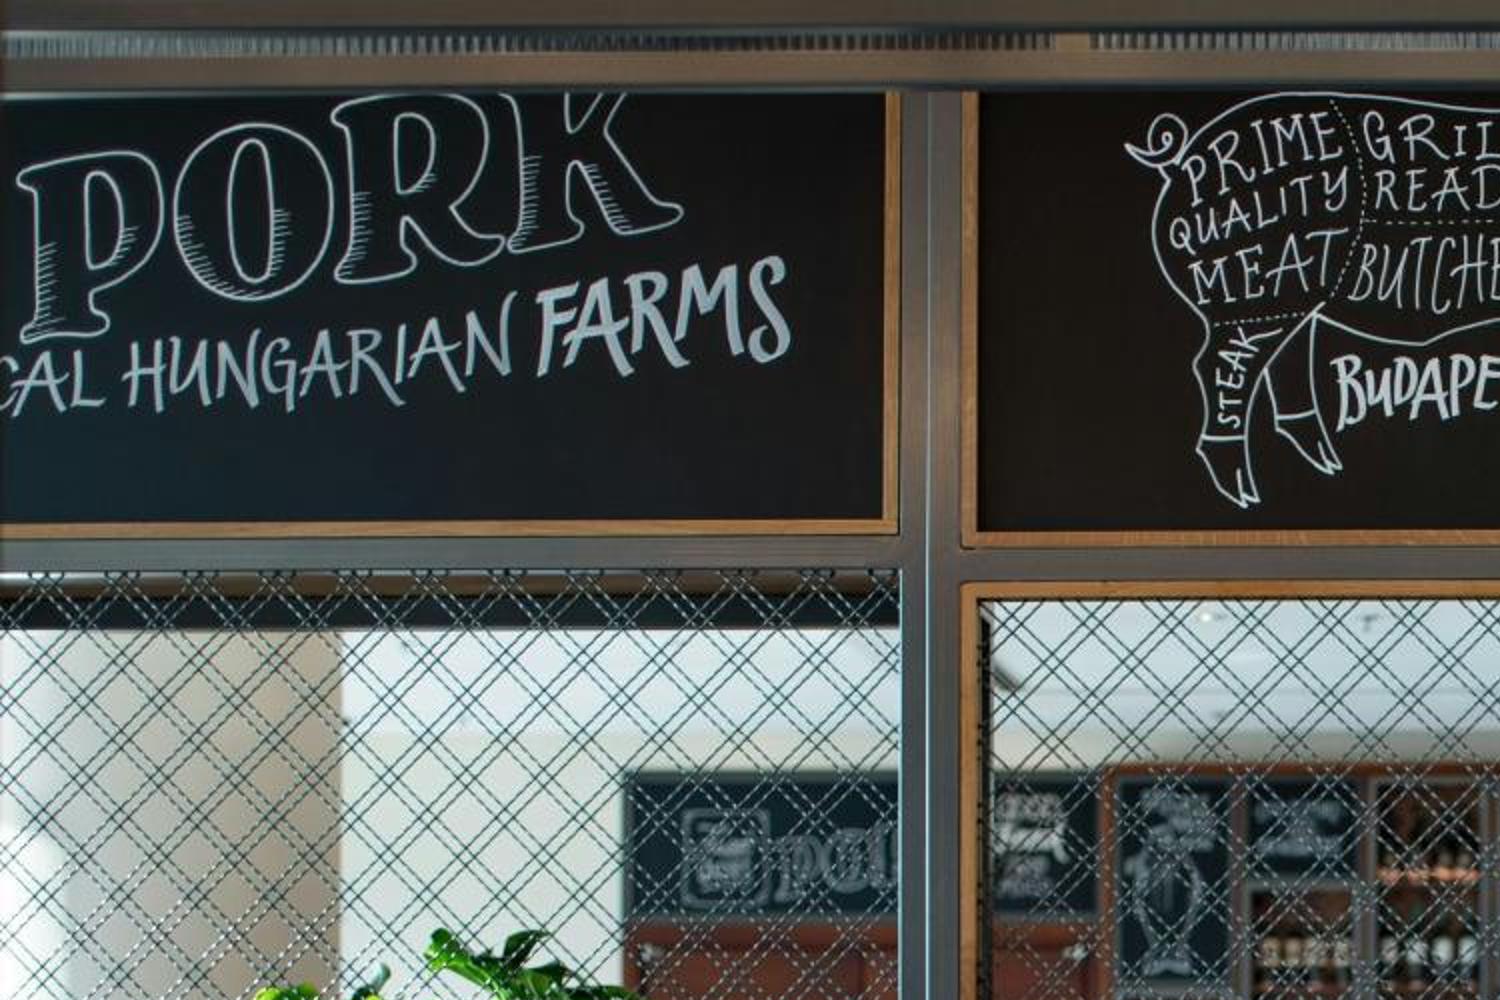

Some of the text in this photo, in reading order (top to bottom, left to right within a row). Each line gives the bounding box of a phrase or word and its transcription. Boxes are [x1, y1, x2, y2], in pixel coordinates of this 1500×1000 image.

[1182, 112, 1342, 207] PRIME
[16, 93, 684, 345] PORK
[1170, 166, 1348, 255] QUALITY
[1188, 228, 1348, 305] MEAT
[122, 291, 517, 413] HUNGARIAN
[536, 256, 790, 377] FARMS
[1216, 327, 1283, 429] STEAK
